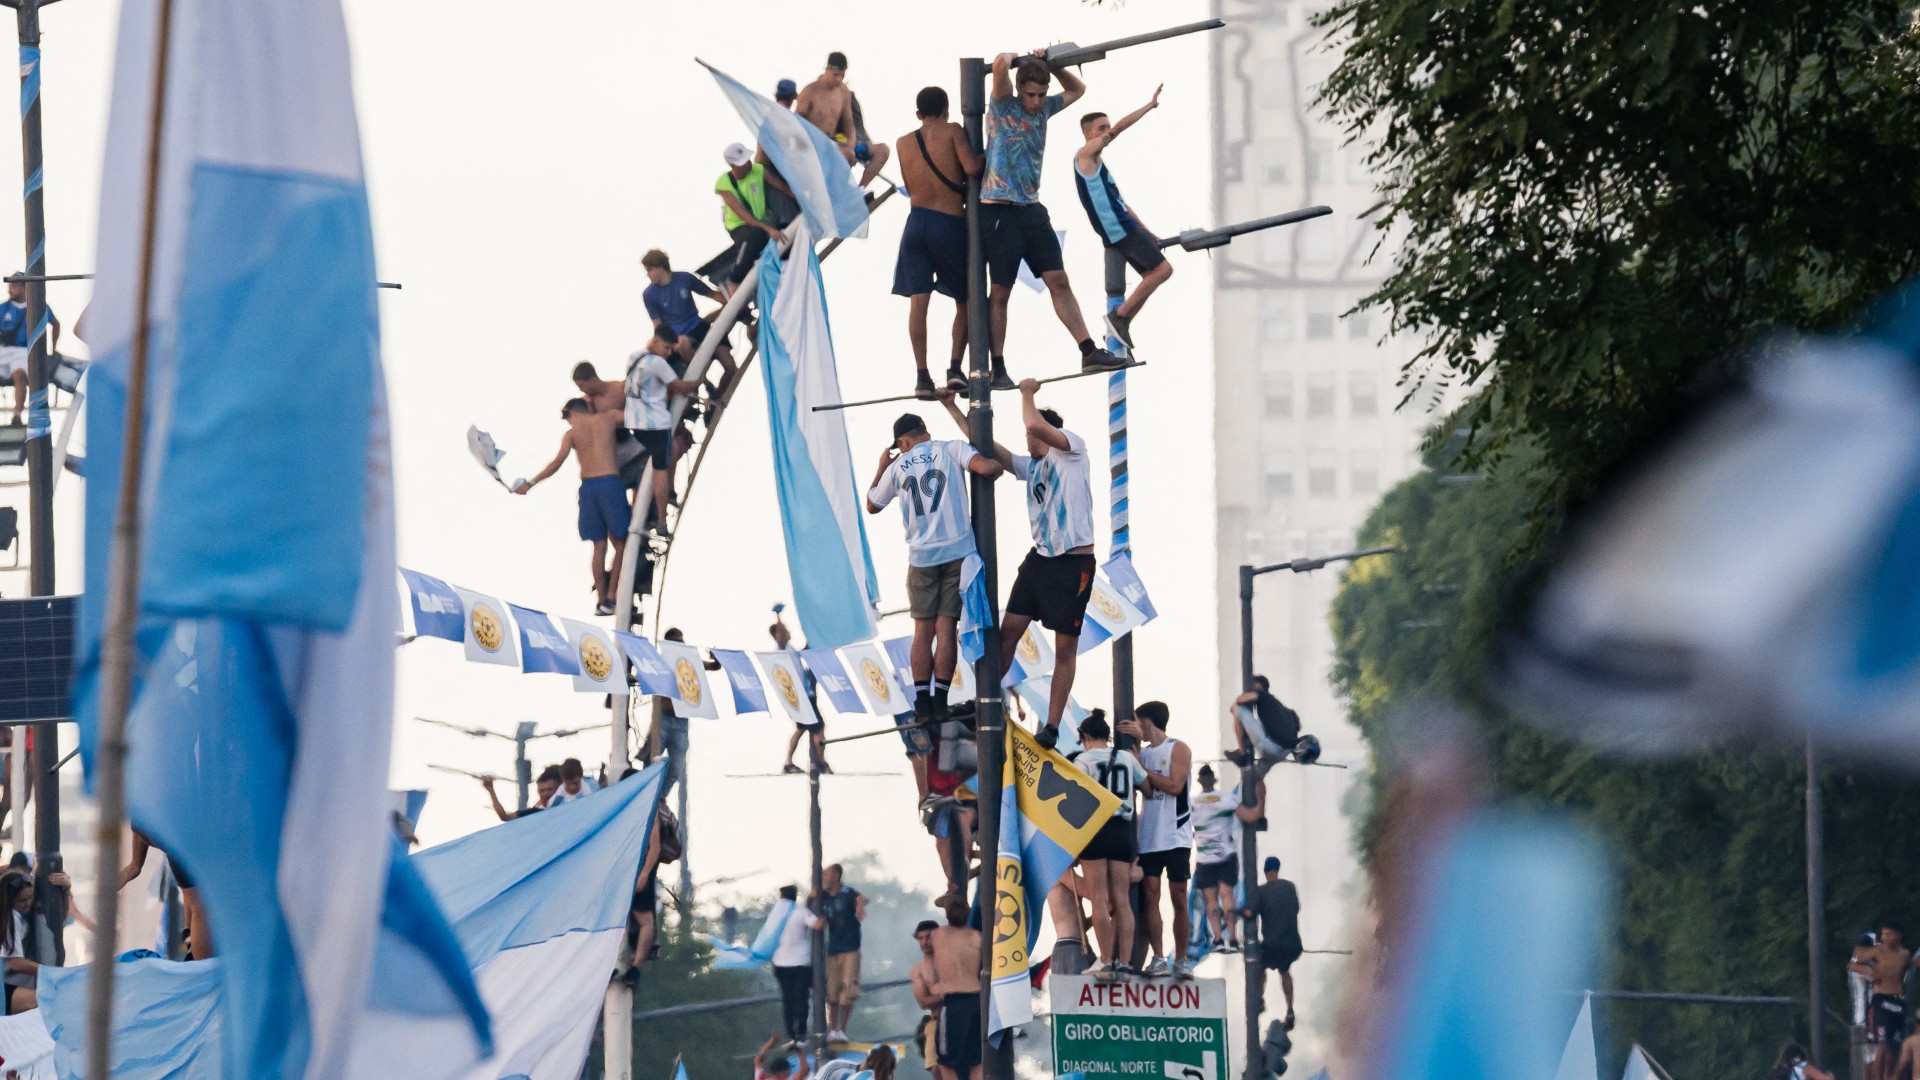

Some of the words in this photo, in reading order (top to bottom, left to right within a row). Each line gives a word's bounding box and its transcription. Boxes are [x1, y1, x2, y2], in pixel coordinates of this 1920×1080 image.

[899, 453, 938, 473] MESSI
[902, 468, 947, 517] 19
[1011, 735, 1040, 763] Ciuda
[1013, 767, 1036, 788] Buen
[1096, 761, 1130, 801] 10
[1078, 983, 1201, 1009] ATENCION
[1064, 1022, 1104, 1041] GIRO
[1107, 1023, 1215, 1043] OBLIGATORIO
[1061, 1059, 1117, 1074] DIAGONAL
[1119, 1060, 1157, 1075] NORTE
